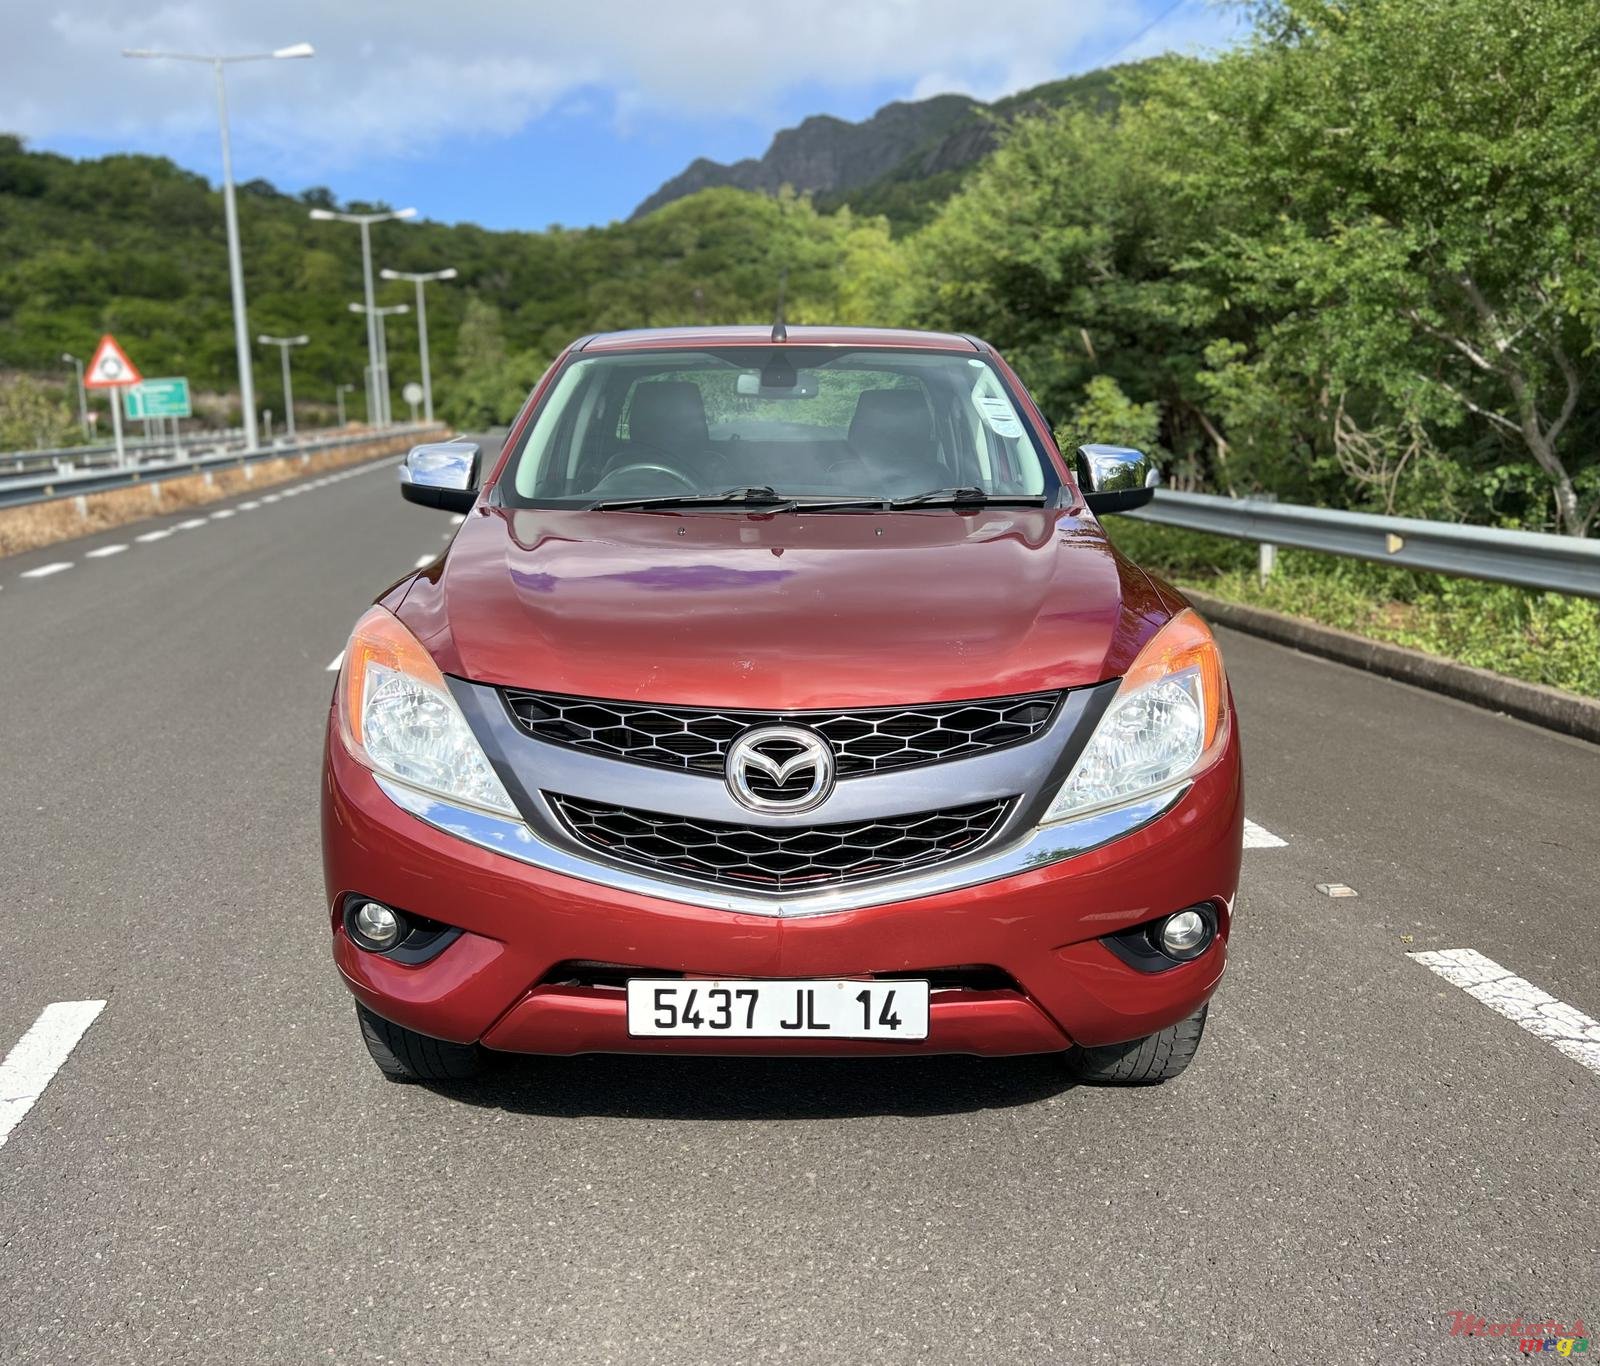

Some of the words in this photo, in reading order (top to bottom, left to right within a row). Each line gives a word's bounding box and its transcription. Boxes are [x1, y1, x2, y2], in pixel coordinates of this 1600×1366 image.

[654, 989, 758, 1029] 5437
[780, 989, 830, 1030] JL
[855, 990, 902, 1030] 14
